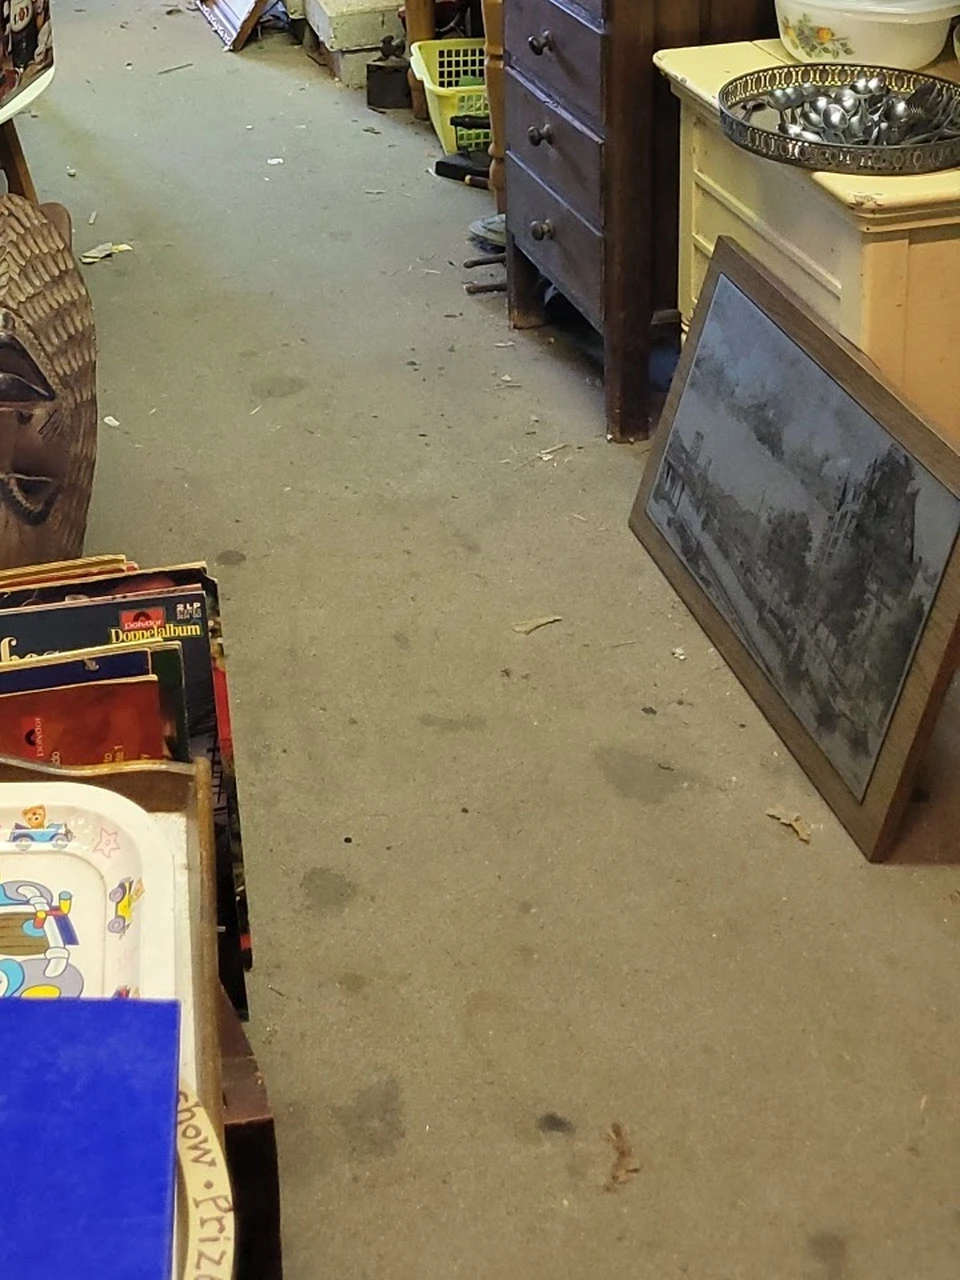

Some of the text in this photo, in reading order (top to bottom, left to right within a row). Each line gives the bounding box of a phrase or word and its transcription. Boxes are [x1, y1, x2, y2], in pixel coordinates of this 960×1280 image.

[110, 623, 201, 643] Doppelalbum
[124, 619, 162, 630] Polydor
[35, 718, 44, 757] Polydor
[192, 1195, 234, 1280] Priz
